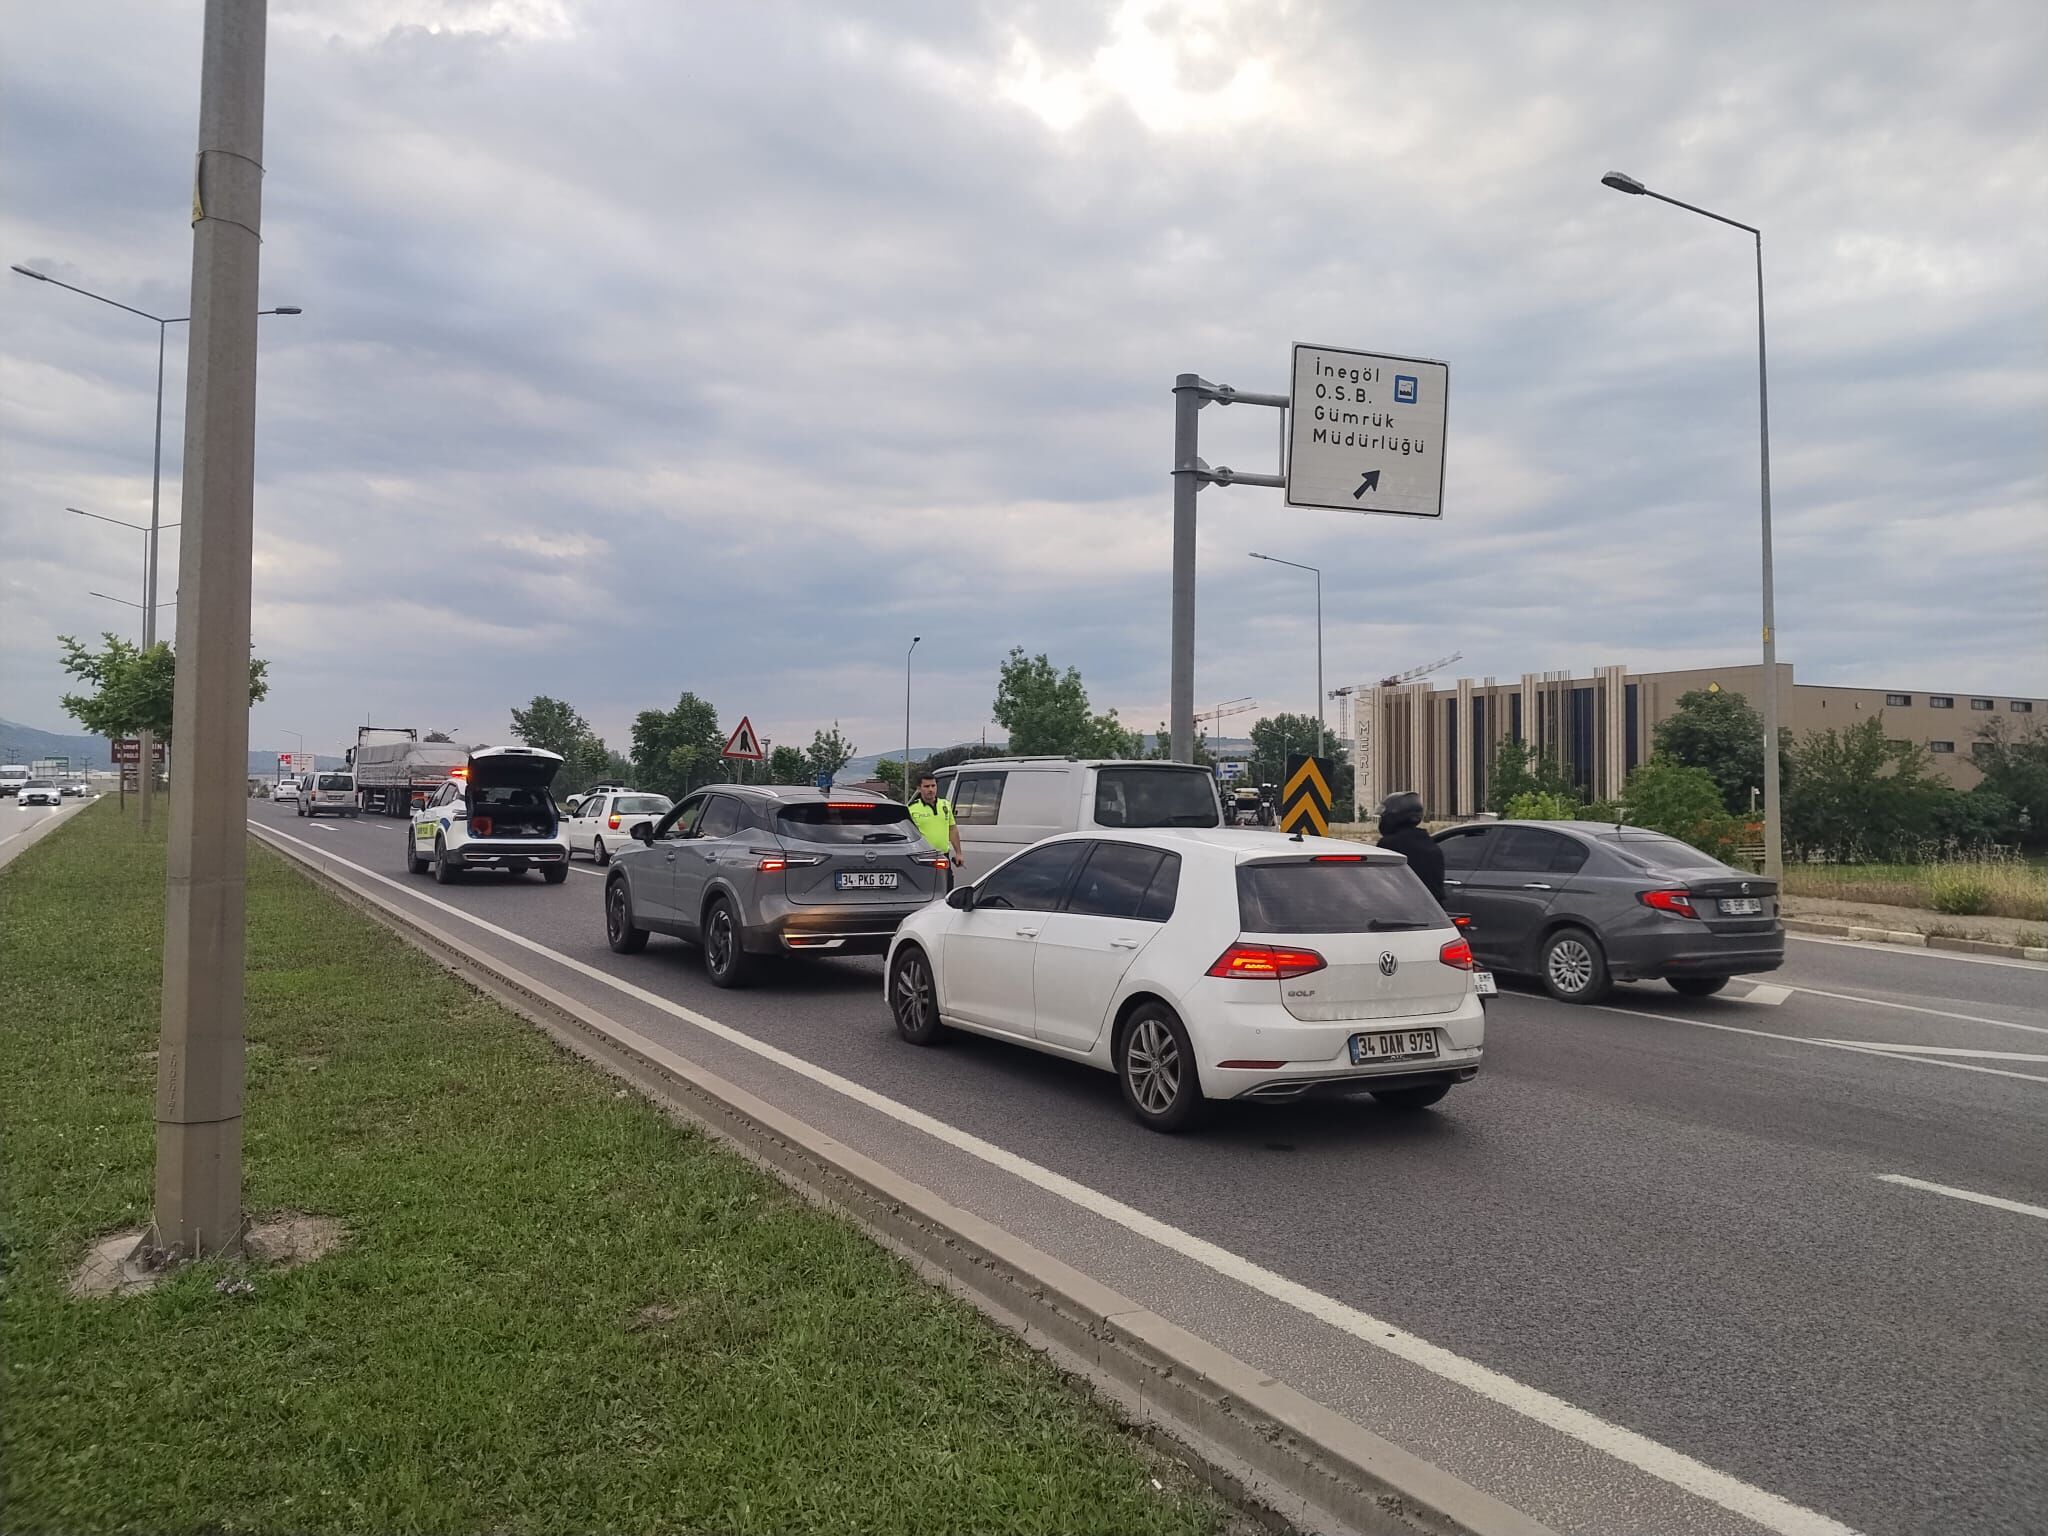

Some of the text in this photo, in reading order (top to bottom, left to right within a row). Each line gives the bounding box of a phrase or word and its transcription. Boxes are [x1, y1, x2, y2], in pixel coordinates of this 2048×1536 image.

[1316, 357, 1380, 383] İnegöl
[1315, 383, 1372, 404] O.S.B.
[1314, 405, 1395, 429] Gümrük
[1313, 428, 1425, 456] Müdürlüğü
[1359, 720, 1369, 786] MERT
[843, 874, 895, 885] 34 PKG 827
[1287, 989, 1316, 998] GOLF
[1358, 1032, 1433, 1057] 34 DAN 979
